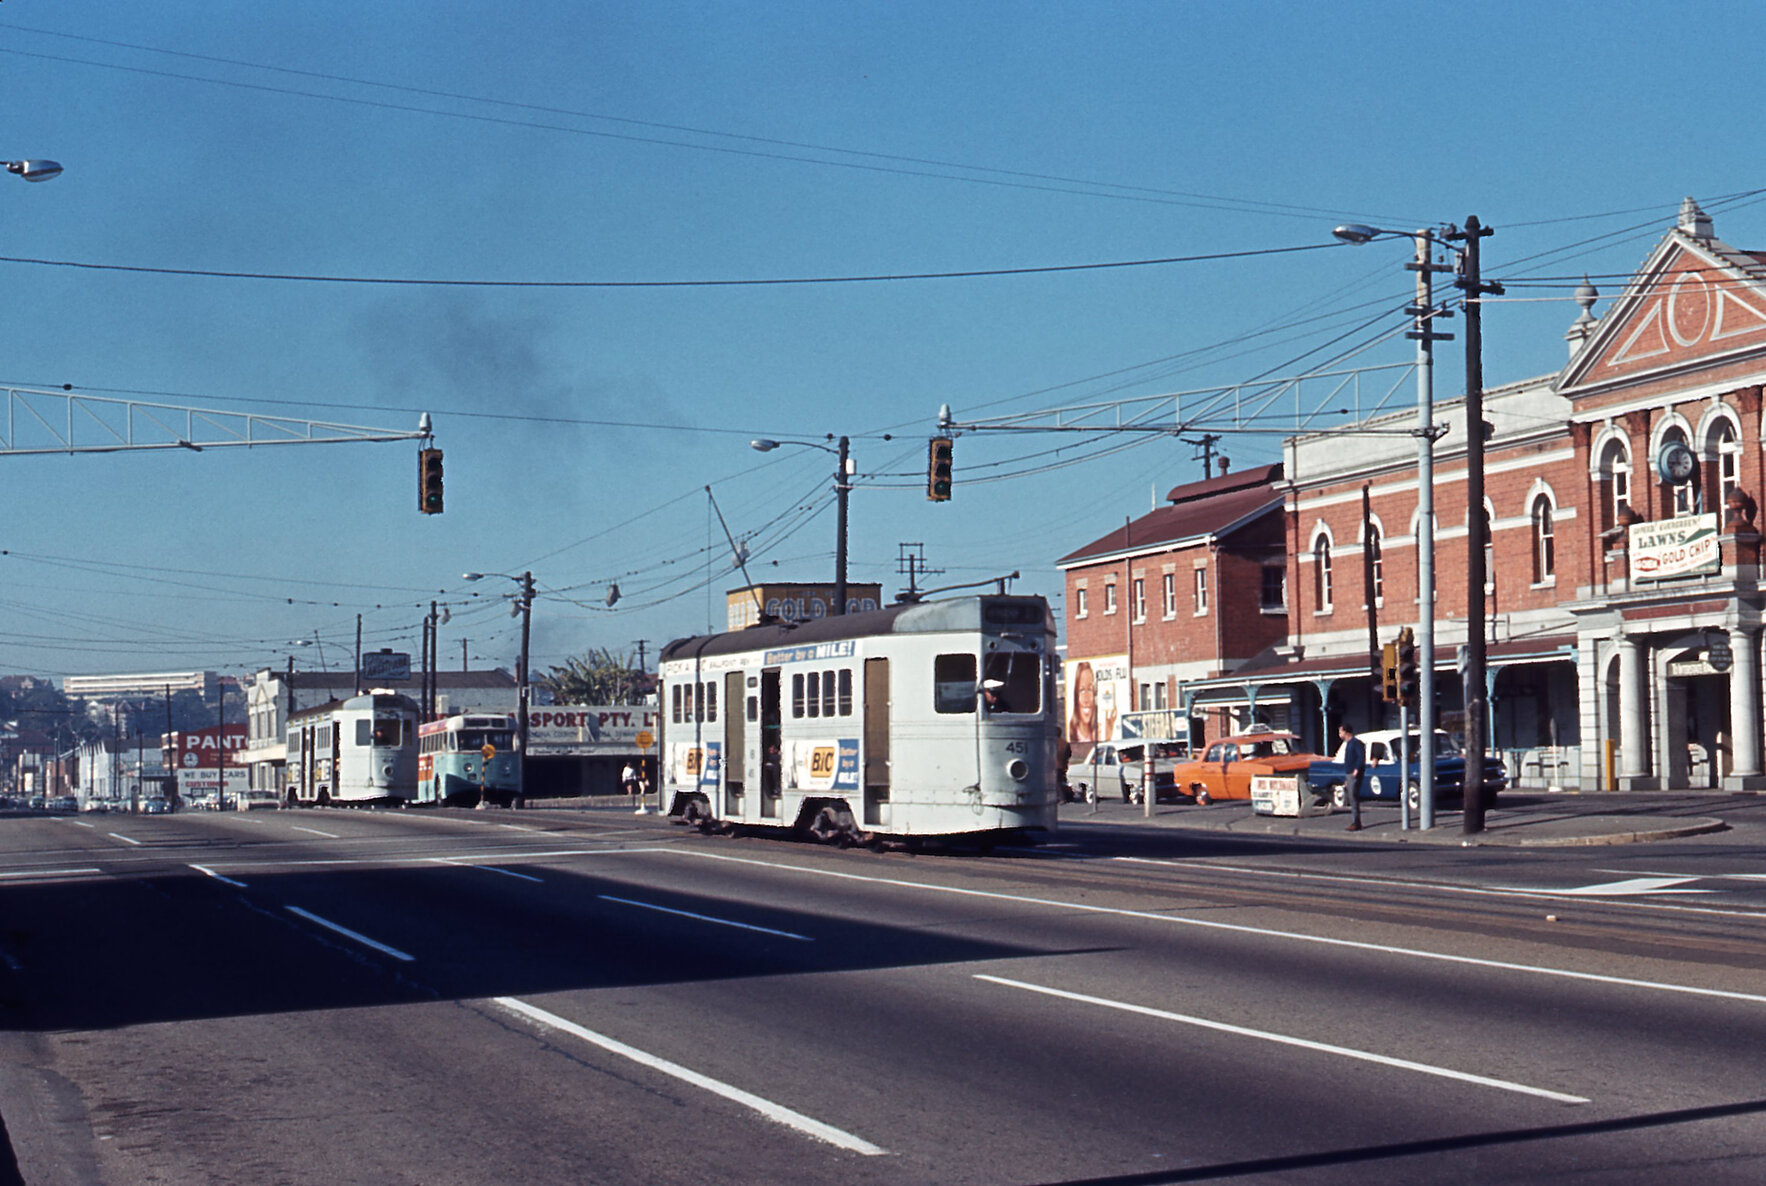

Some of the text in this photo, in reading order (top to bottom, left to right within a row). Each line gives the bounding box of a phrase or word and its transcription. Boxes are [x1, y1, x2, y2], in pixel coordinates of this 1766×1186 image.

[1638, 530, 1686, 550] LAWNS
[1662, 548, 1686, 566] GOLD
[1689, 539, 1711, 558] CHIP
[765, 597, 827, 622] GOLD
[830, 597, 878, 616] OP
[816, 641, 852, 659] MILE!
[599, 712, 635, 727] PTY.
[643, 712, 659, 727] LT
[1006, 741, 1028, 755] 451
[200, 771, 217, 779] BUY
